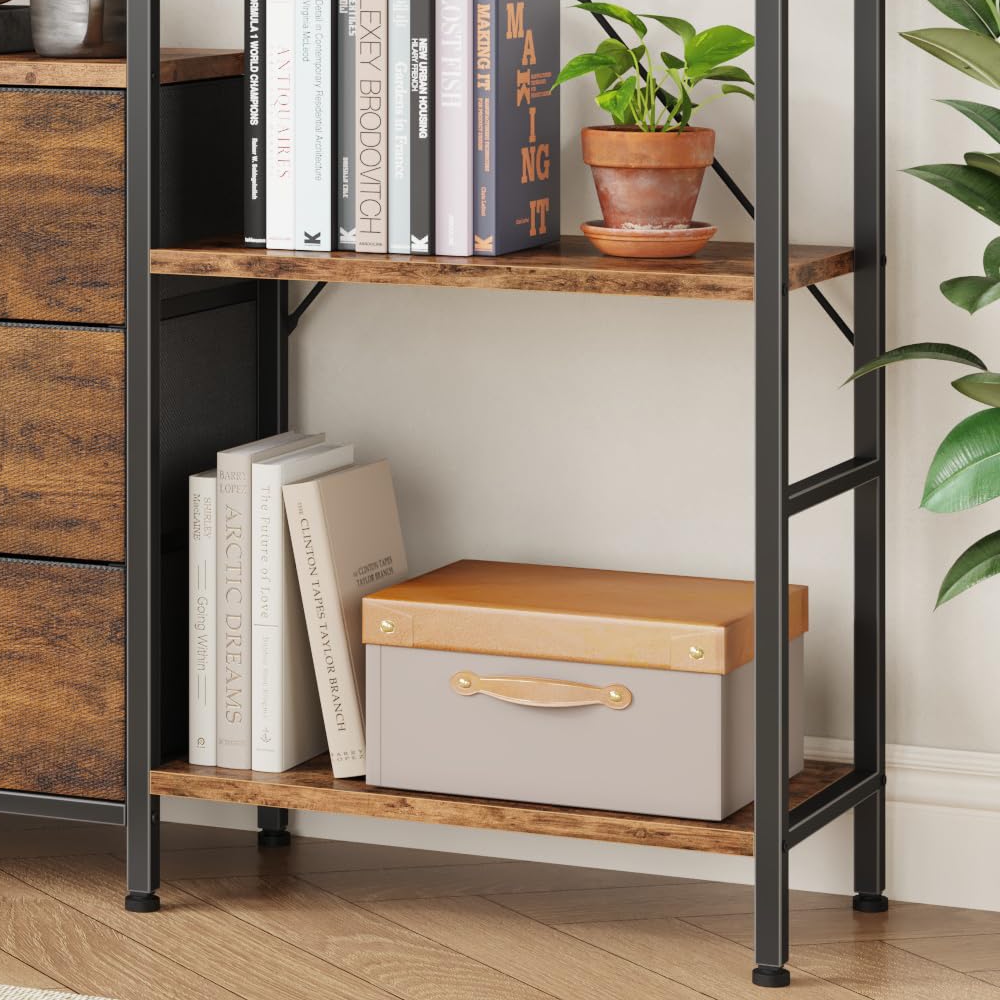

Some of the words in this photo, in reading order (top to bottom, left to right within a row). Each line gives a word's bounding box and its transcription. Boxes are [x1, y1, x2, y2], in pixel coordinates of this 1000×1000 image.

[301, 0, 311, 30] Virginia
[315, 0, 323, 22] Detail
[302, 31, 311, 62] McLeod
[419, 38, 427, 59] NEW
[477, 4, 490, 70] MAKING
[250, 41, 259, 72] WORLD
[312, 33, 323, 87] Contemporary
[394, 61, 406, 114] Gardens
[419, 62, 427, 94] URBAN
[441, 57, 462, 108] FISH
[477, 74, 490, 91] IT
[250, 74, 259, 125] CHAMPIONS
[273, 47, 291, 178] ANTIQUAIRES
[315, 90, 323, 132] Residential
[419, 96, 427, 138] HOUSING
[394, 117, 406, 129] in
[315, 135, 323, 181] Architecture
[359, 80, 382, 234] BRODOVITCH
[394, 135, 406, 179] France
[219, 470, 247, 480] BARRY
[220, 484, 248, 493] LOPEZ
[260, 486, 270, 511] The
[203, 497, 212, 540] SHIRLEY
[225, 504, 242, 603] ARCTIC
[260, 517, 270, 562] Future
[260, 568, 271, 582] of
[356, 574, 374, 586] TAYLOR
[375, 567, 393, 581] BRANCH
[358, 562, 379, 576] CLINTON
[379, 556, 393, 569] TAPES
[194, 596, 208, 631] Going
[260, 587, 270, 618] Love
[300, 518, 318, 576] CLINTON
[311, 580, 326, 619] TAPES
[320, 622, 335, 674] TAYLOR
[328, 677, 346, 732] BRANCH
[197, 634, 208, 672] Within
[225, 613, 242, 724] DREAMS
